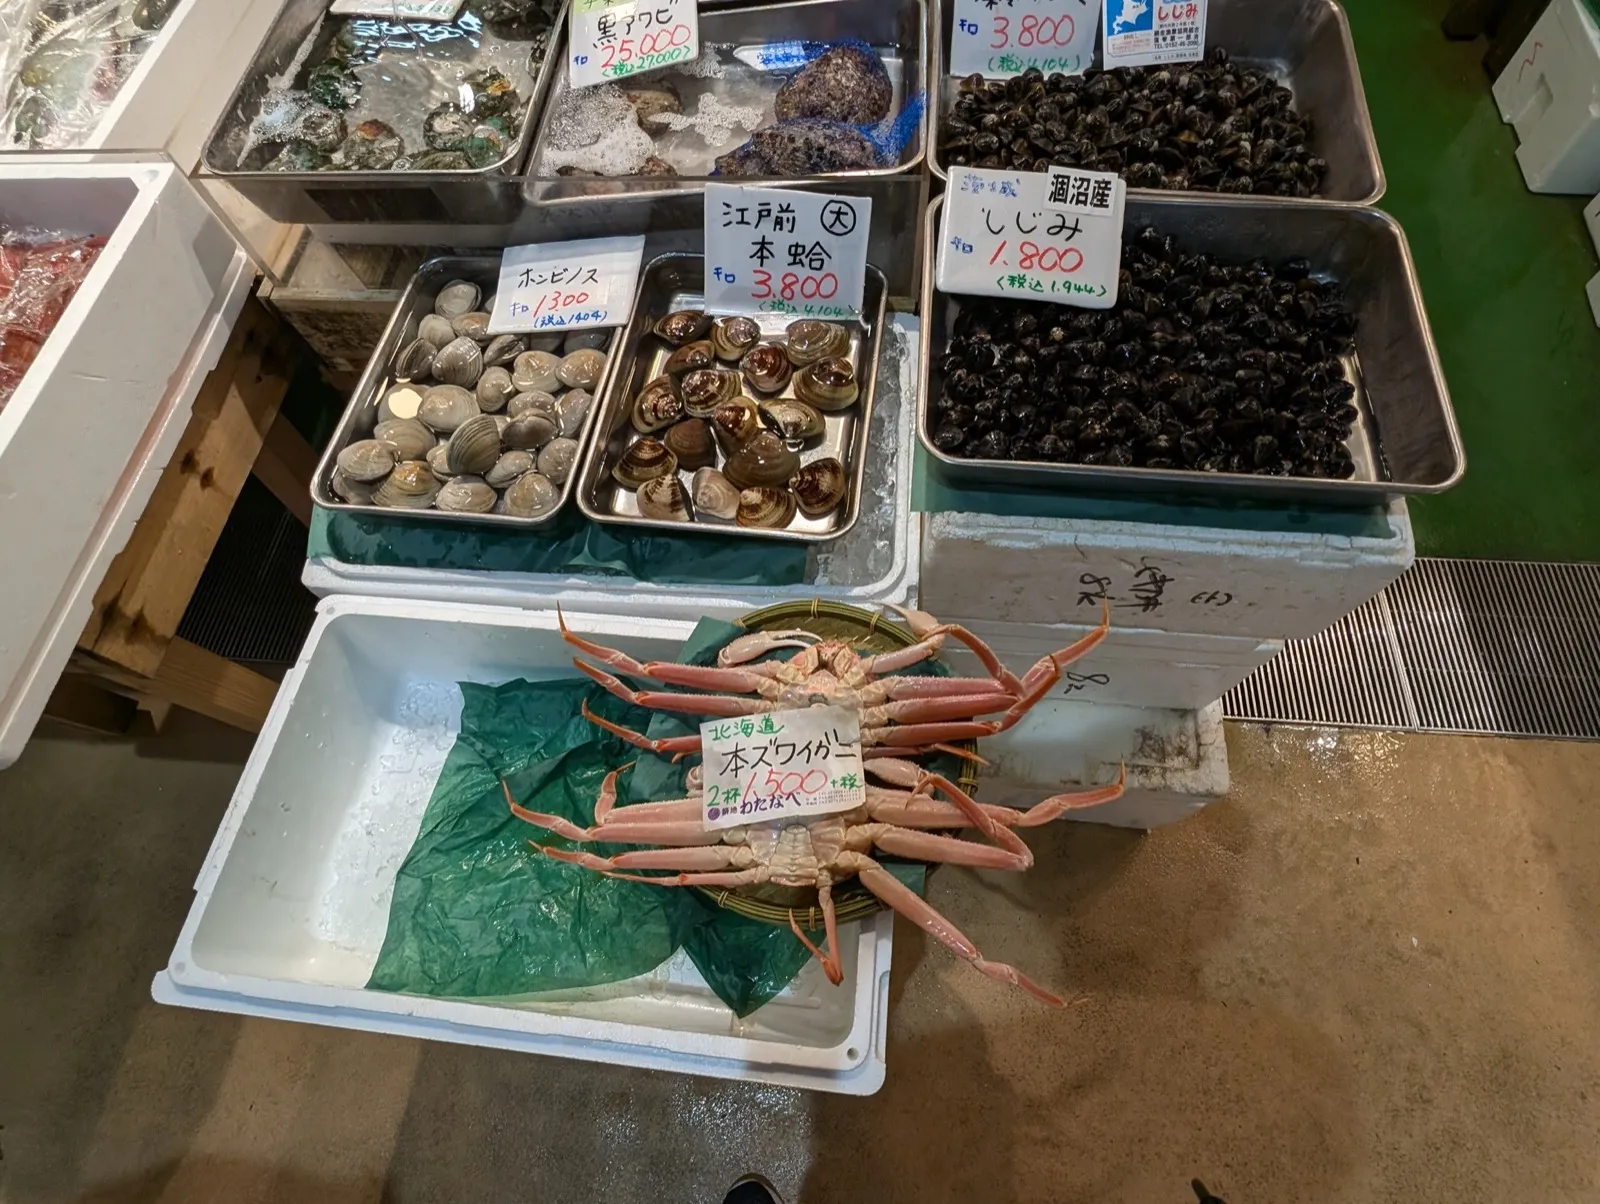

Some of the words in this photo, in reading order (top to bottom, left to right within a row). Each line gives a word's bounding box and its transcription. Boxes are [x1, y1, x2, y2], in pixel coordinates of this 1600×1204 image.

[1157, 3, 1198, 21] しじみ
[1048, 173, 1112, 209] 涸沼産
[722, 201, 796, 233] 江戸前
[981, 208, 1083, 242] しじみ
[518, 267, 598, 288] ホンビノス
[708, 714, 785, 741] 北海道
[719, 728, 857, 778] 本ズワイガニ
[707, 785, 741, 807] 2杯
